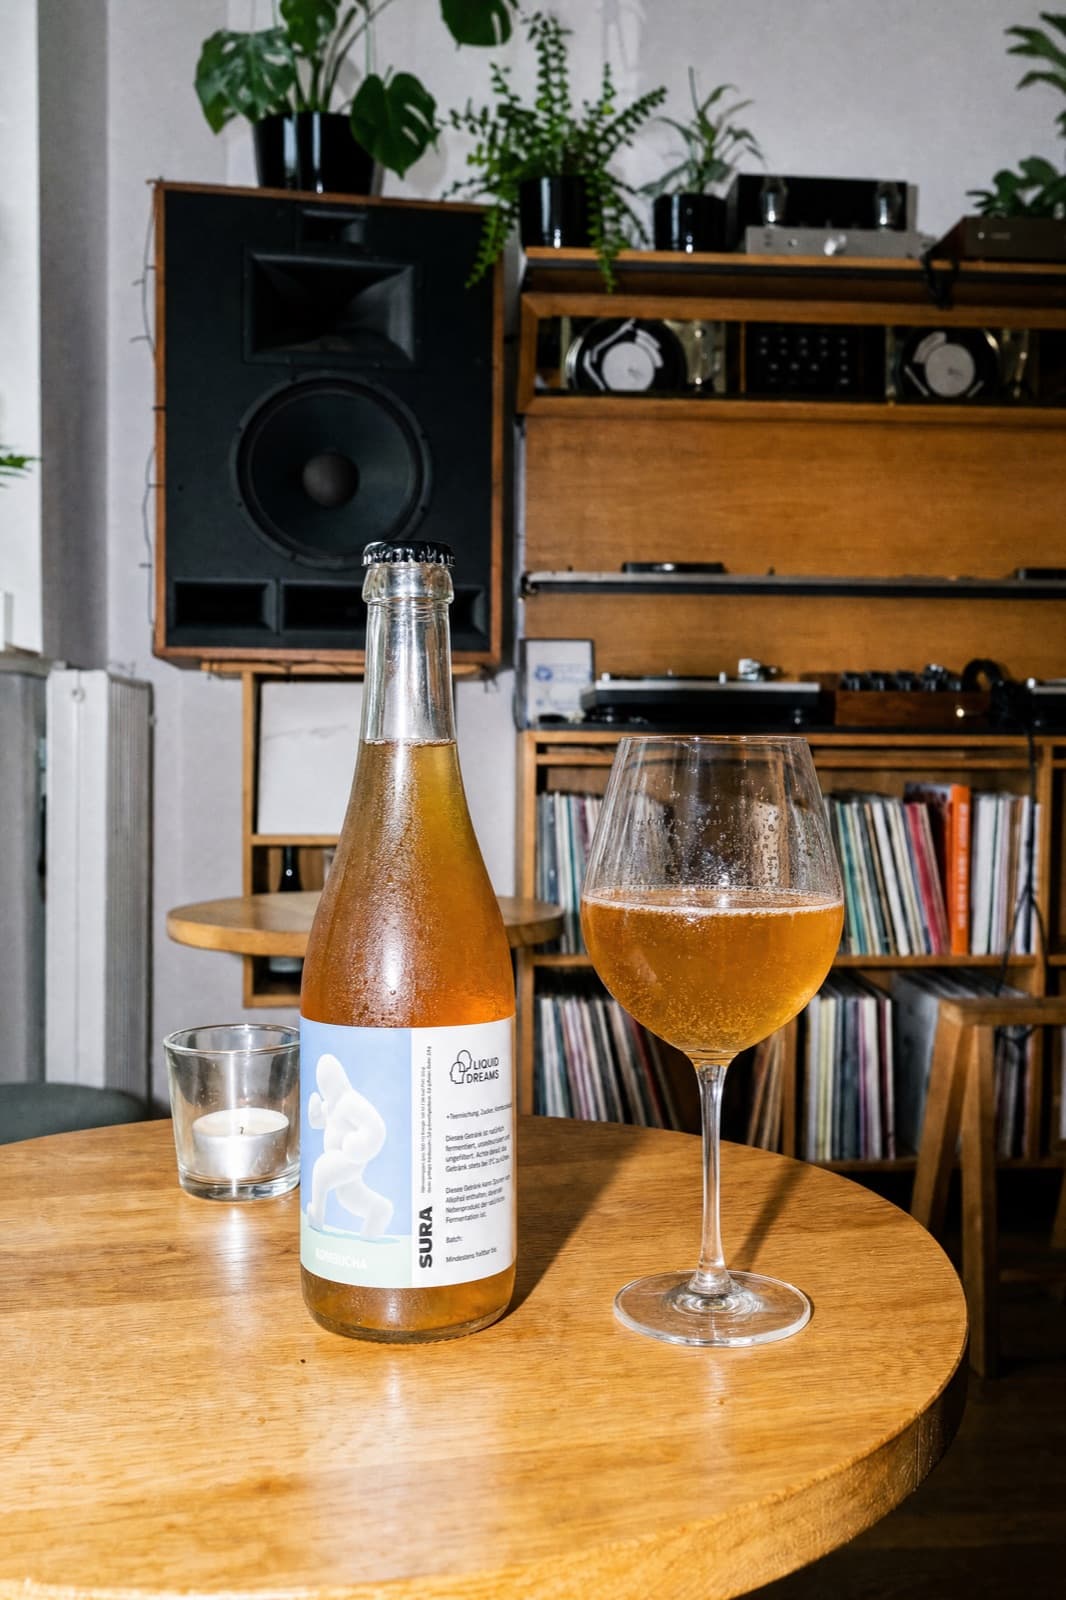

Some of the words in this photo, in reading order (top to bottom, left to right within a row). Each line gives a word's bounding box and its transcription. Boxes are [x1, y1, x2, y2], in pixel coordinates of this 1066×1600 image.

[473, 1057, 499, 1070] LIQUID
[466, 1070, 499, 1084] DREAMS
[419, 1206, 432, 1268] SURA
